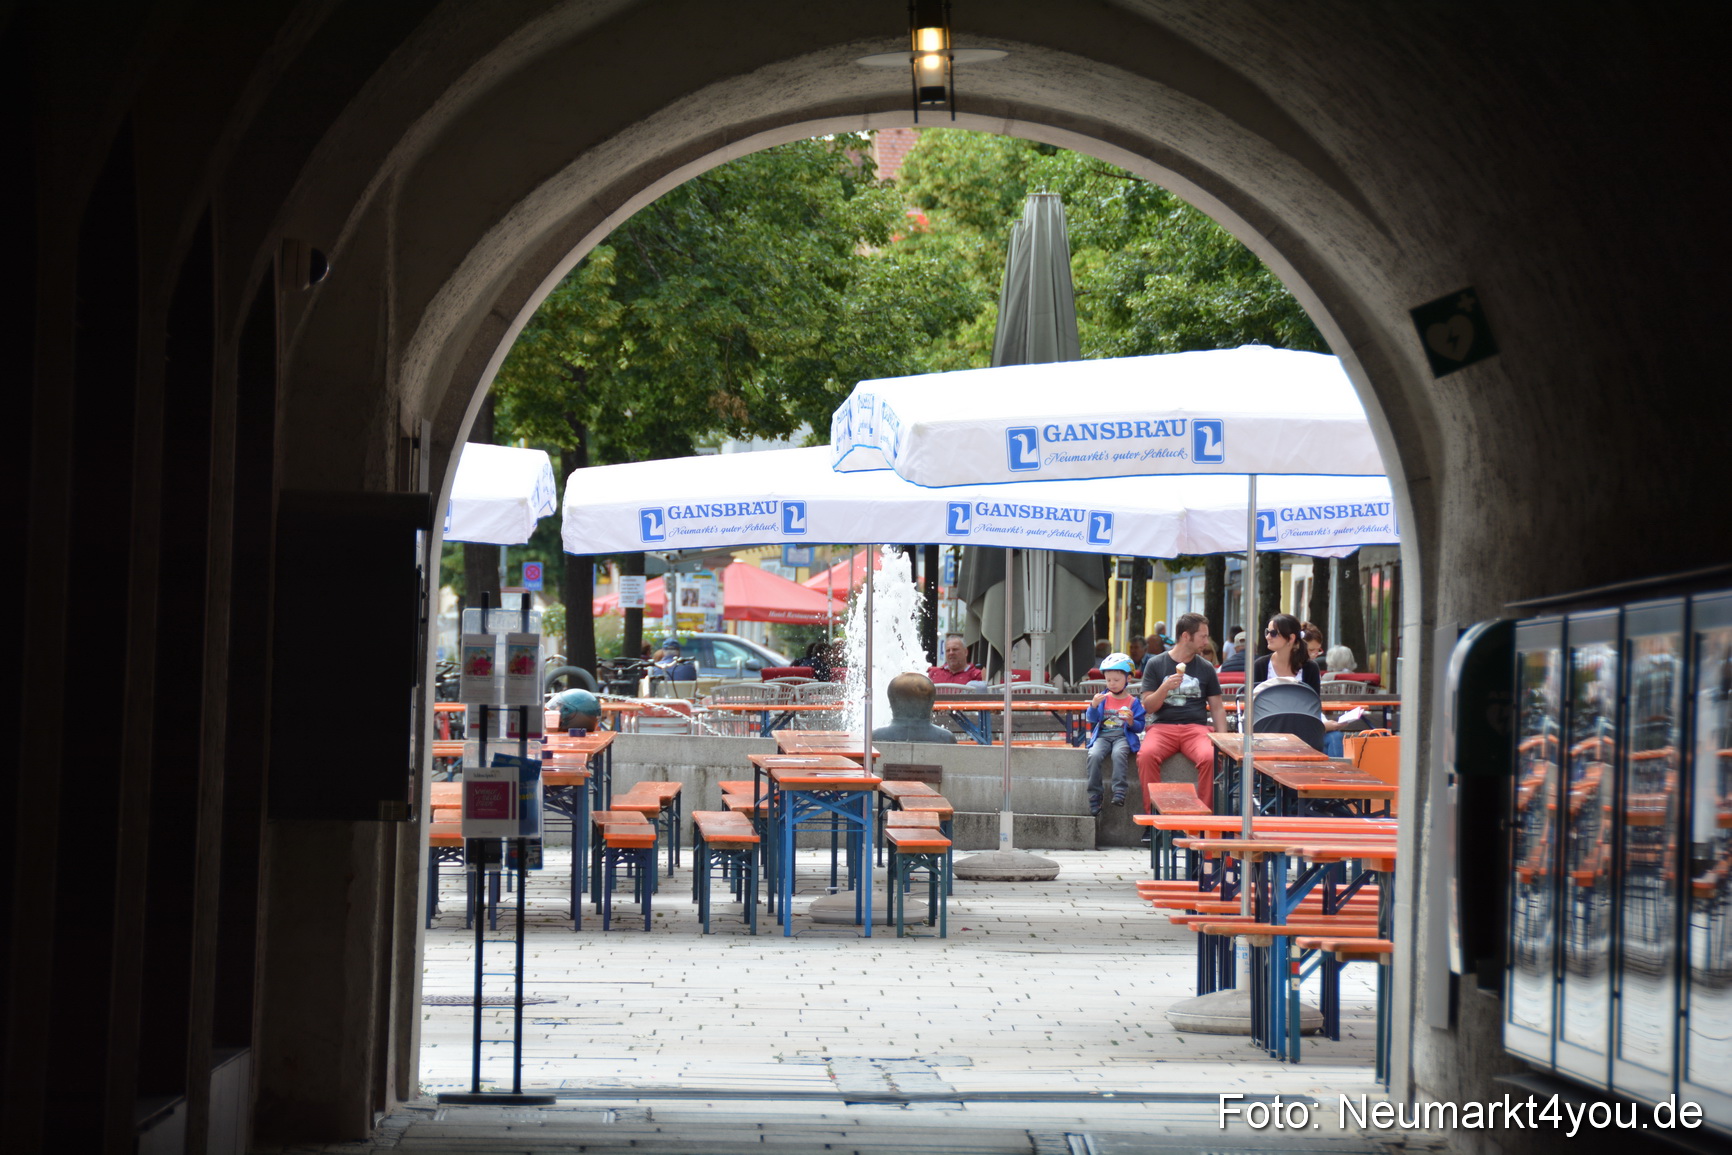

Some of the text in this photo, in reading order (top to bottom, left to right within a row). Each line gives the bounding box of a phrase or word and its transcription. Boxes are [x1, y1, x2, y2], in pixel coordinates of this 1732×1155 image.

[1043, 419, 1187, 442] GANSBRÄU
[1044, 449, 1110, 465] Neumarkt's
[1113, 450, 1140, 461] guter
[667, 500, 778, 520] GANSBRÄU
[975, 502, 1086, 523] GANSBRÄU
[1280, 502, 1390, 522] GANSBRÄU
[669, 525, 719, 537] Neumarkt's
[720, 526, 742, 535] guter
[974, 523, 1024, 534] Neumarkt's
[1025, 529, 1048, 537] guter
[1281, 527, 1331, 539] Neumarkt's
[1333, 528, 1354, 536] guter
[1345, 569, 1351, 579] 5
